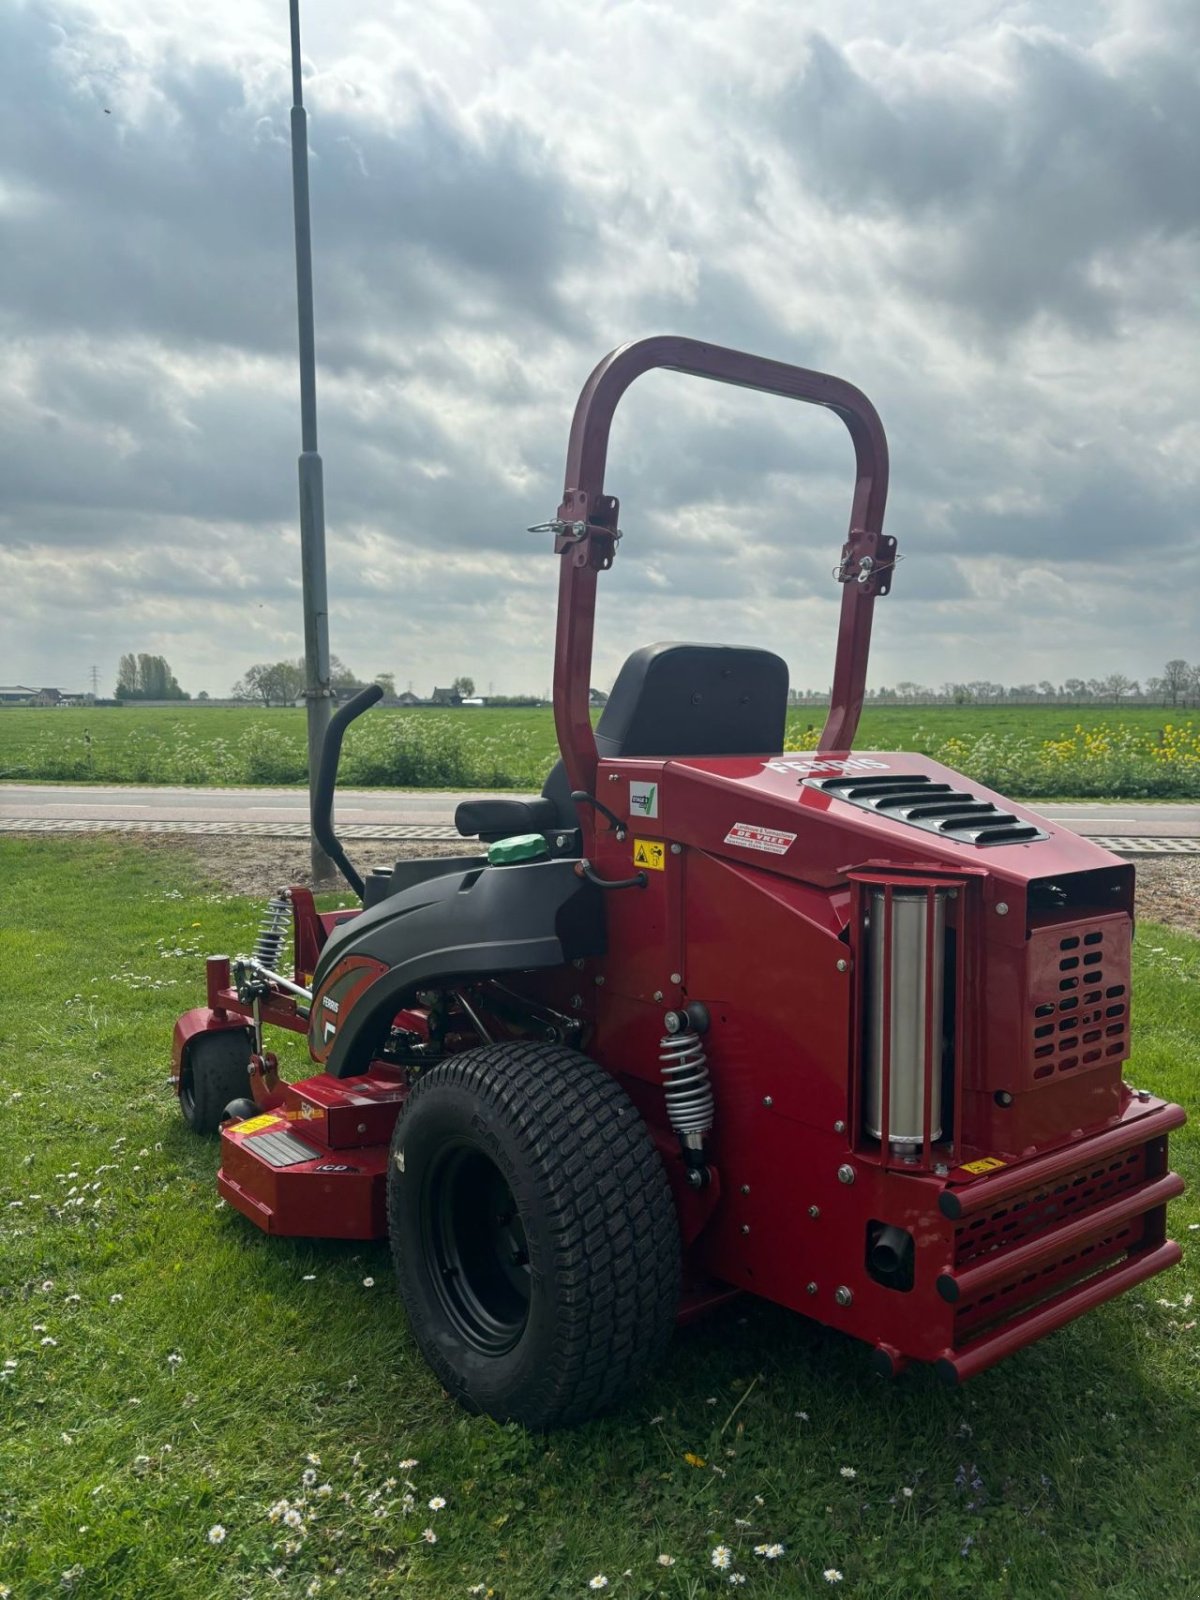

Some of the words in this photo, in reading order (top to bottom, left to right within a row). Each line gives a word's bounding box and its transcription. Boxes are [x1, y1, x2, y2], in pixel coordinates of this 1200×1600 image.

[760, 759, 890, 774] FERRIS
[756, 834, 785, 844] VREE
[322, 995, 340, 1013] FERRIS
